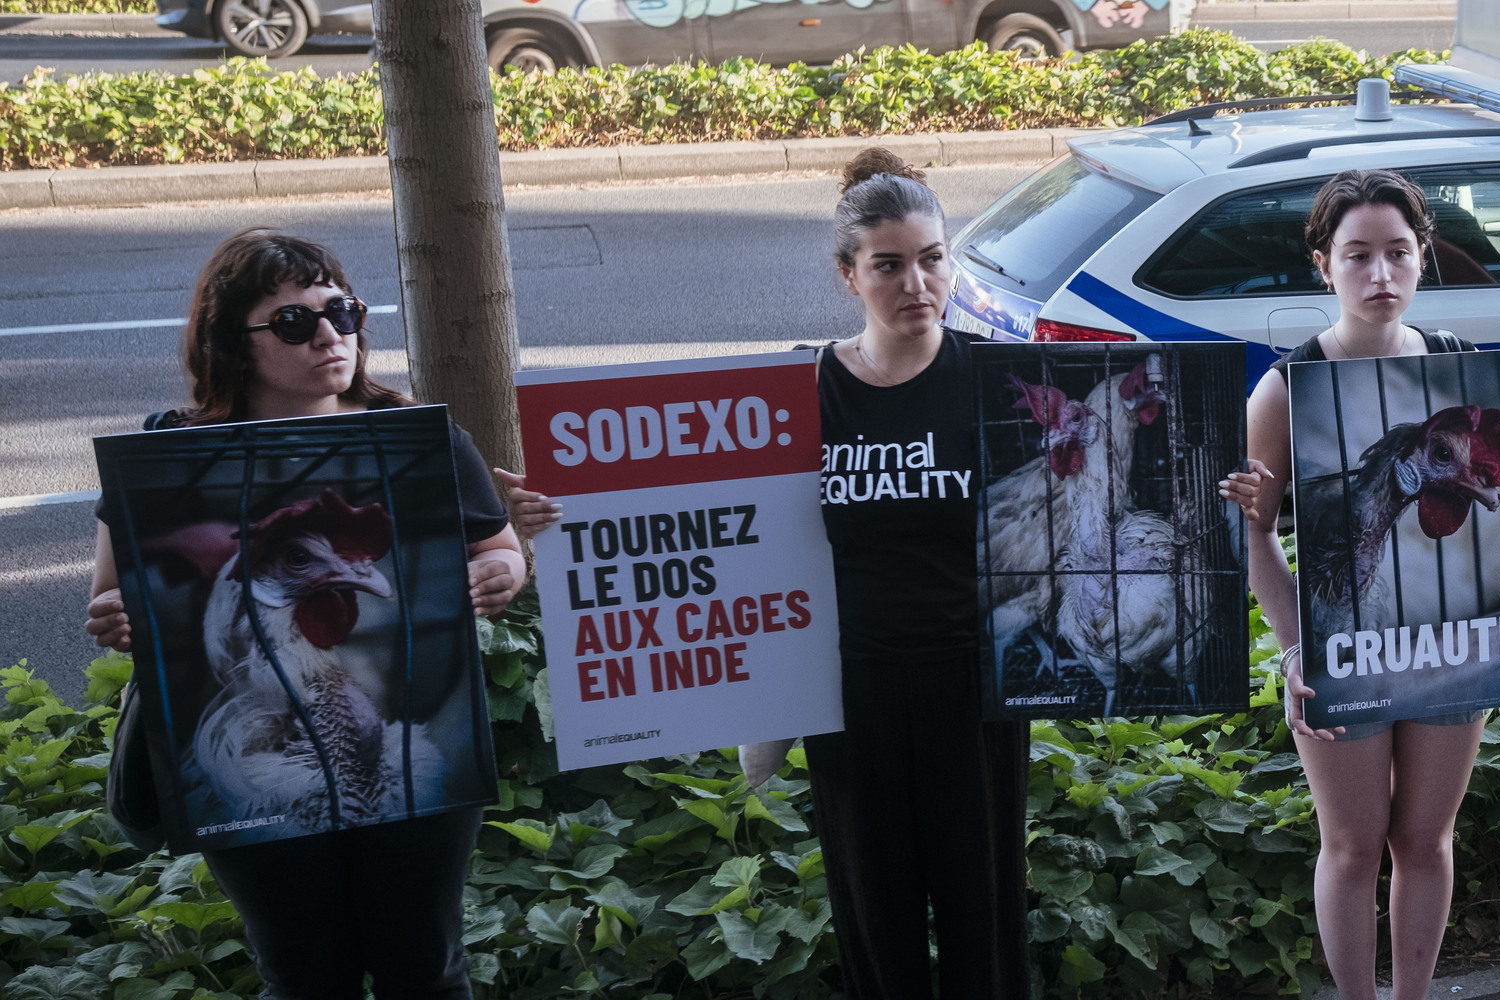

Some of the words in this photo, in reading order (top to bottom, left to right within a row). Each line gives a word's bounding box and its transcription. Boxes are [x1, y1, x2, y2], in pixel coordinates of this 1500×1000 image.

[549, 396, 792, 466] SODEXO:
[561, 504, 759, 563] TOURNEZ
[567, 565, 621, 610] LE
[633, 555, 716, 604] DOS
[574, 606, 663, 656] AUX
[676, 589, 812, 643] CAGES
[578, 654, 636, 702] EN
[650, 642, 750, 693] INDE
